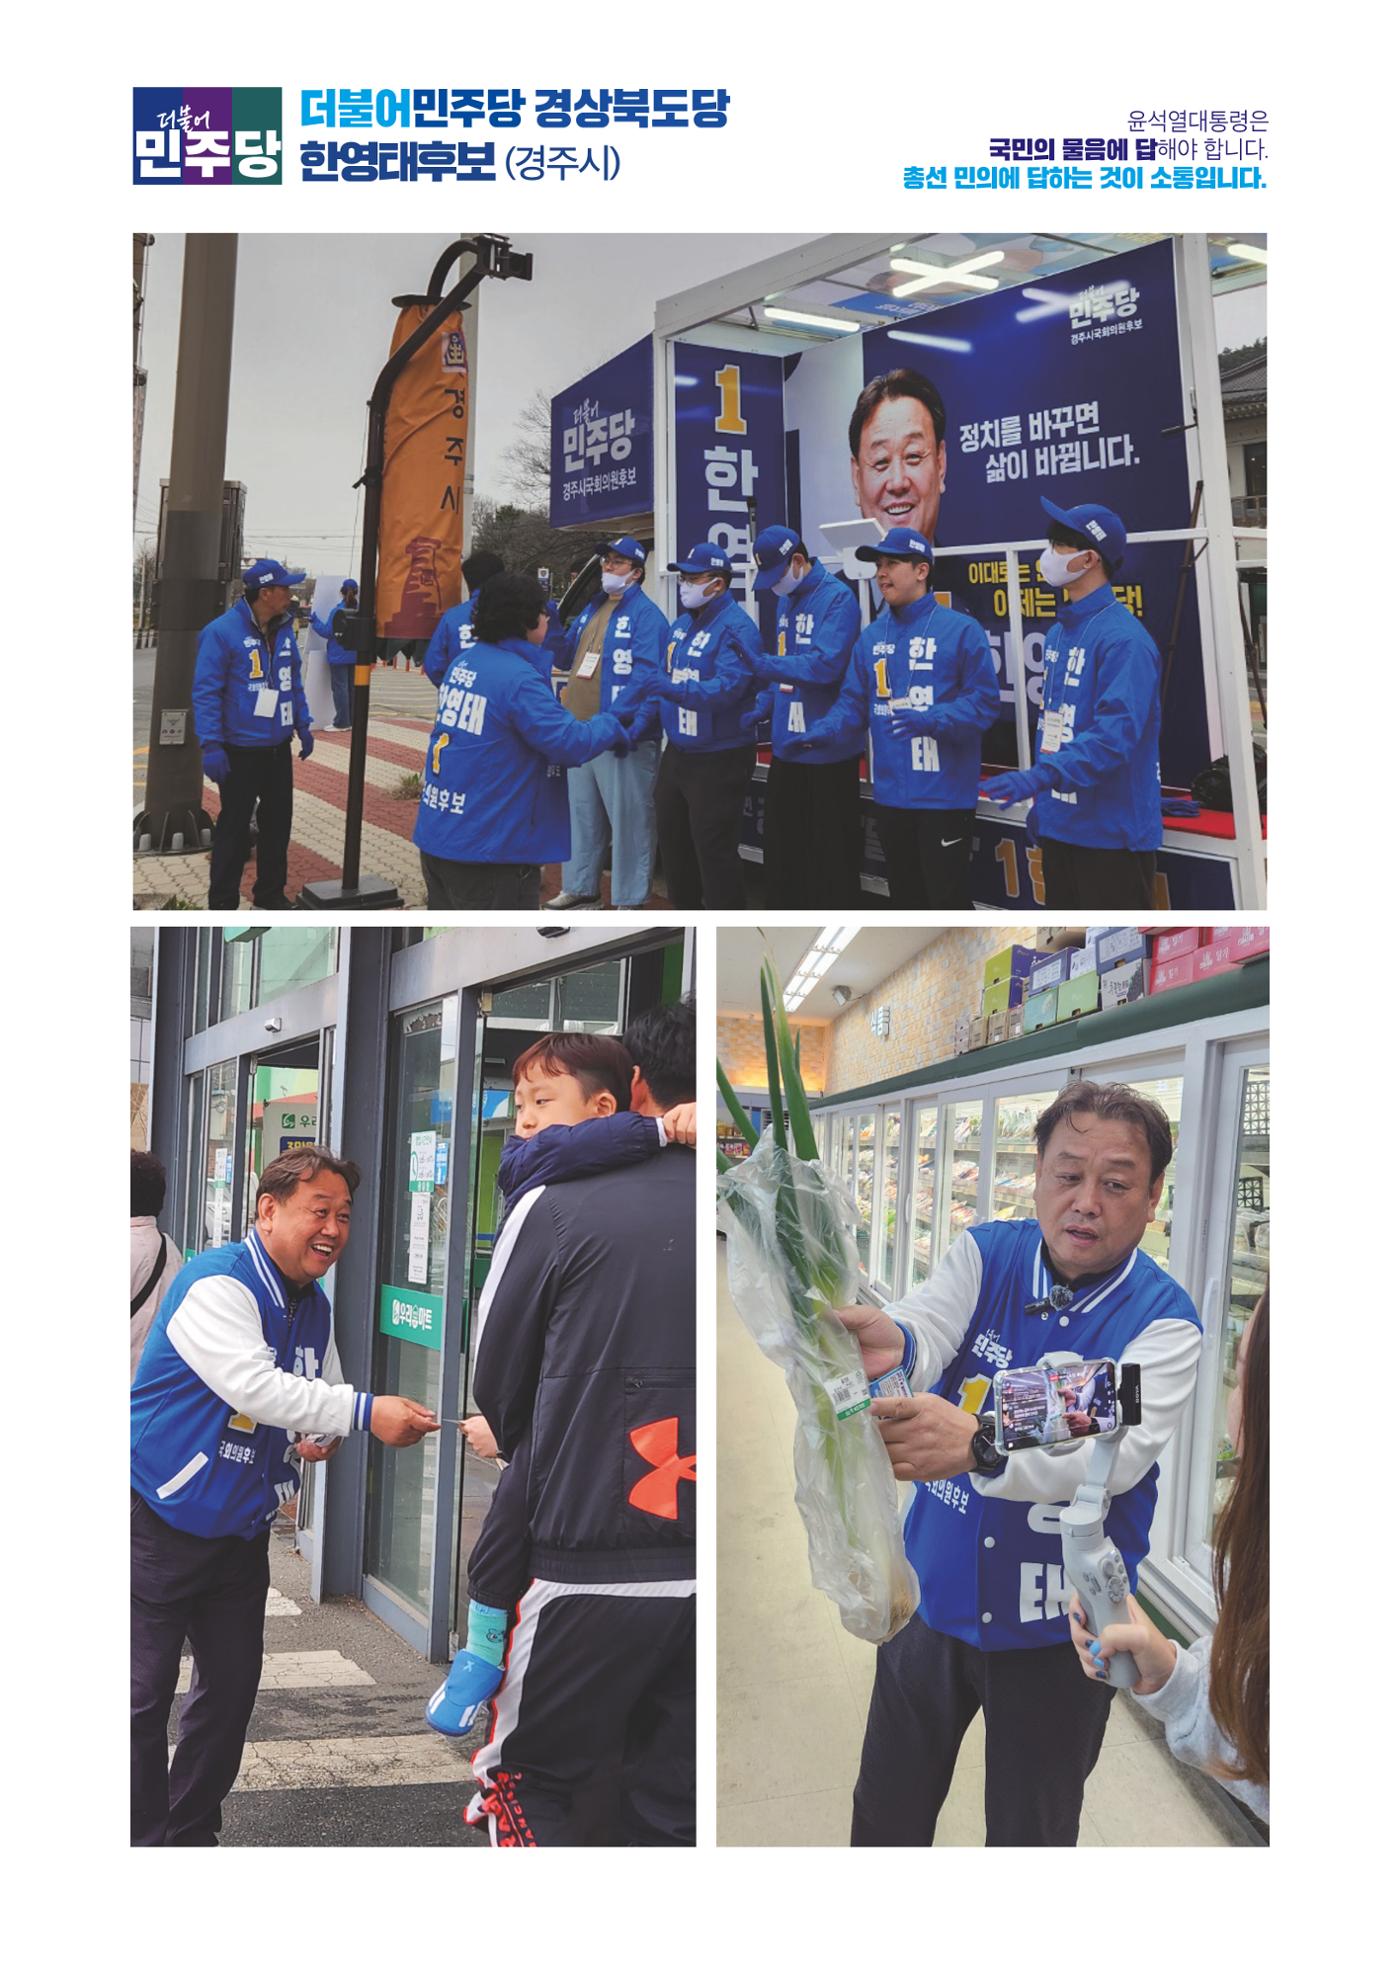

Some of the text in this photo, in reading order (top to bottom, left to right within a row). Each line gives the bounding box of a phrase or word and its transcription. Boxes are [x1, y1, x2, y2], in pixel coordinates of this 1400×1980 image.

[1069, 287, 1140, 330] 민주당
[1070, 318, 1144, 346] 경주시국회의원후보
[714, 364, 748, 436] 1
[562, 407, 636, 473] 민주당
[959, 401, 1100, 454] 정치를 바꾸면
[985, 433, 1141, 484] 삶이 바뀝니다.
[562, 466, 637, 502] 경주시국회의원후보
[249, 649, 264, 679] 1
[449, 666, 477, 689] 민주당
[873, 657, 893, 698] 1
[995, 838, 1020, 898] 1
